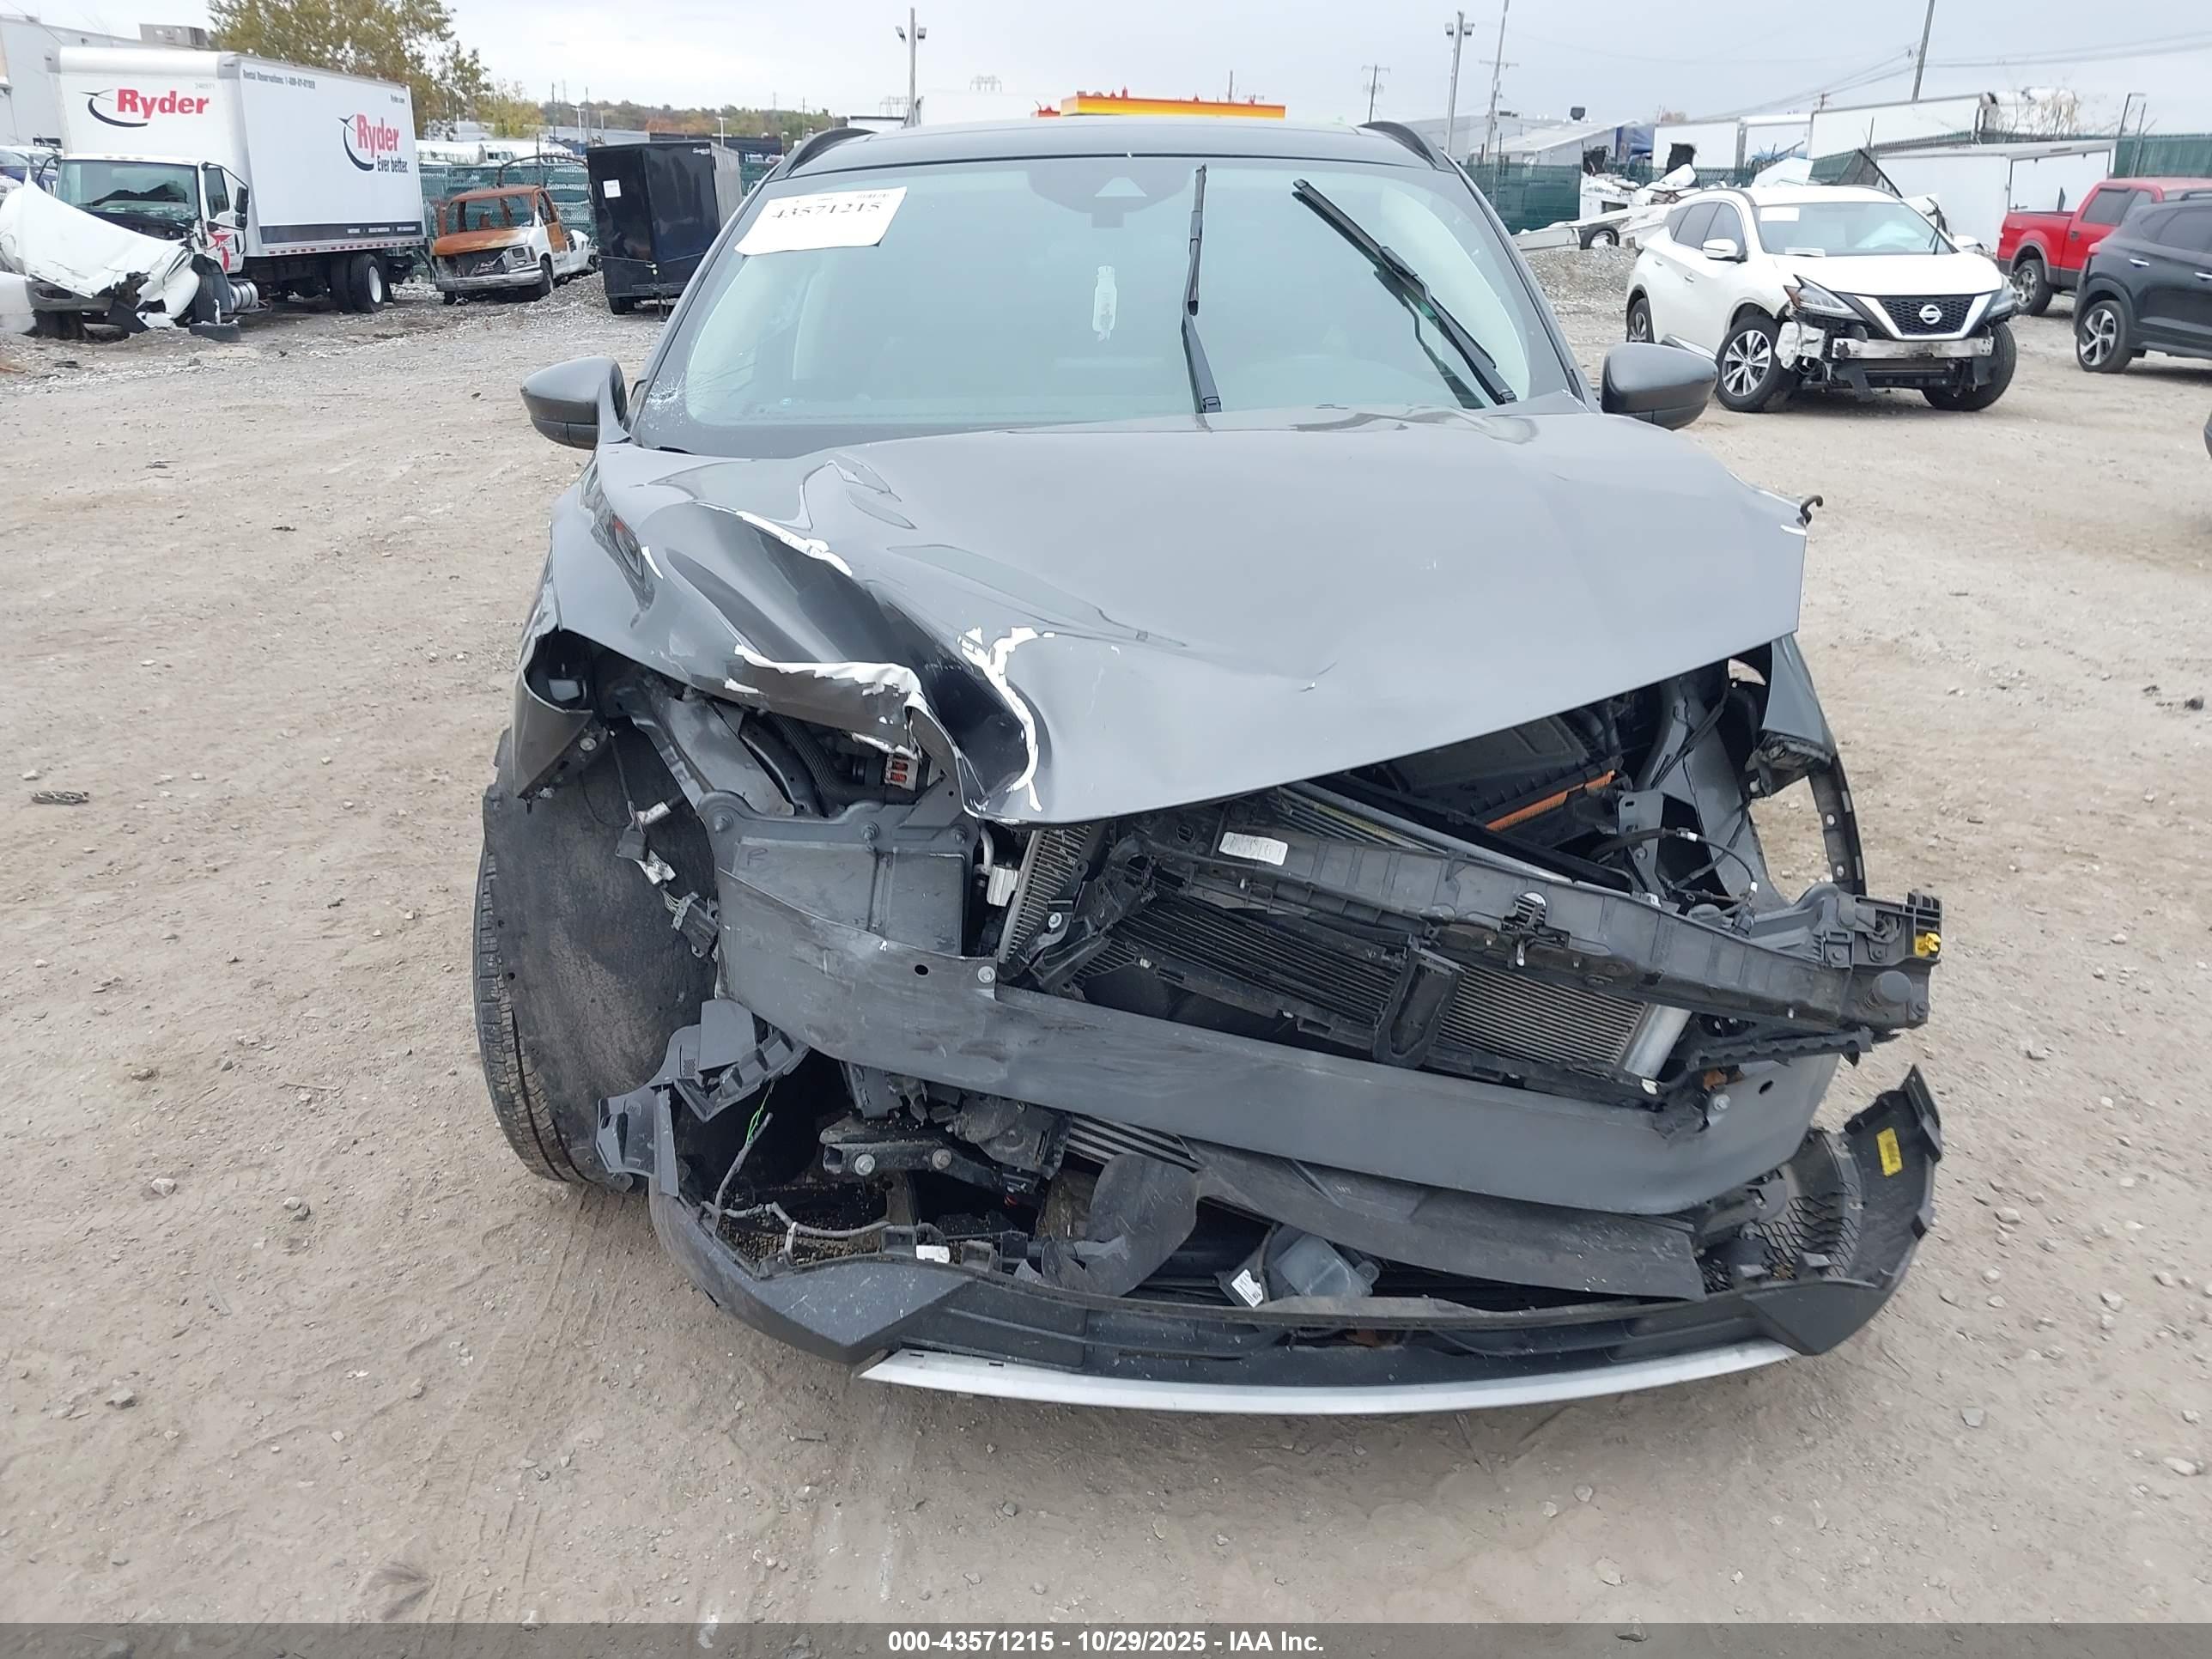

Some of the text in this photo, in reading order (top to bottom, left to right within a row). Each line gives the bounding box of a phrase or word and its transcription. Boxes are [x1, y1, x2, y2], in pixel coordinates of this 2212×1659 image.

[117, 88, 210, 119] Ryder
[356, 113, 399, 159] Ryder
[377, 155, 390, 173] Ever
[771, 201, 883, 219] 43571215
